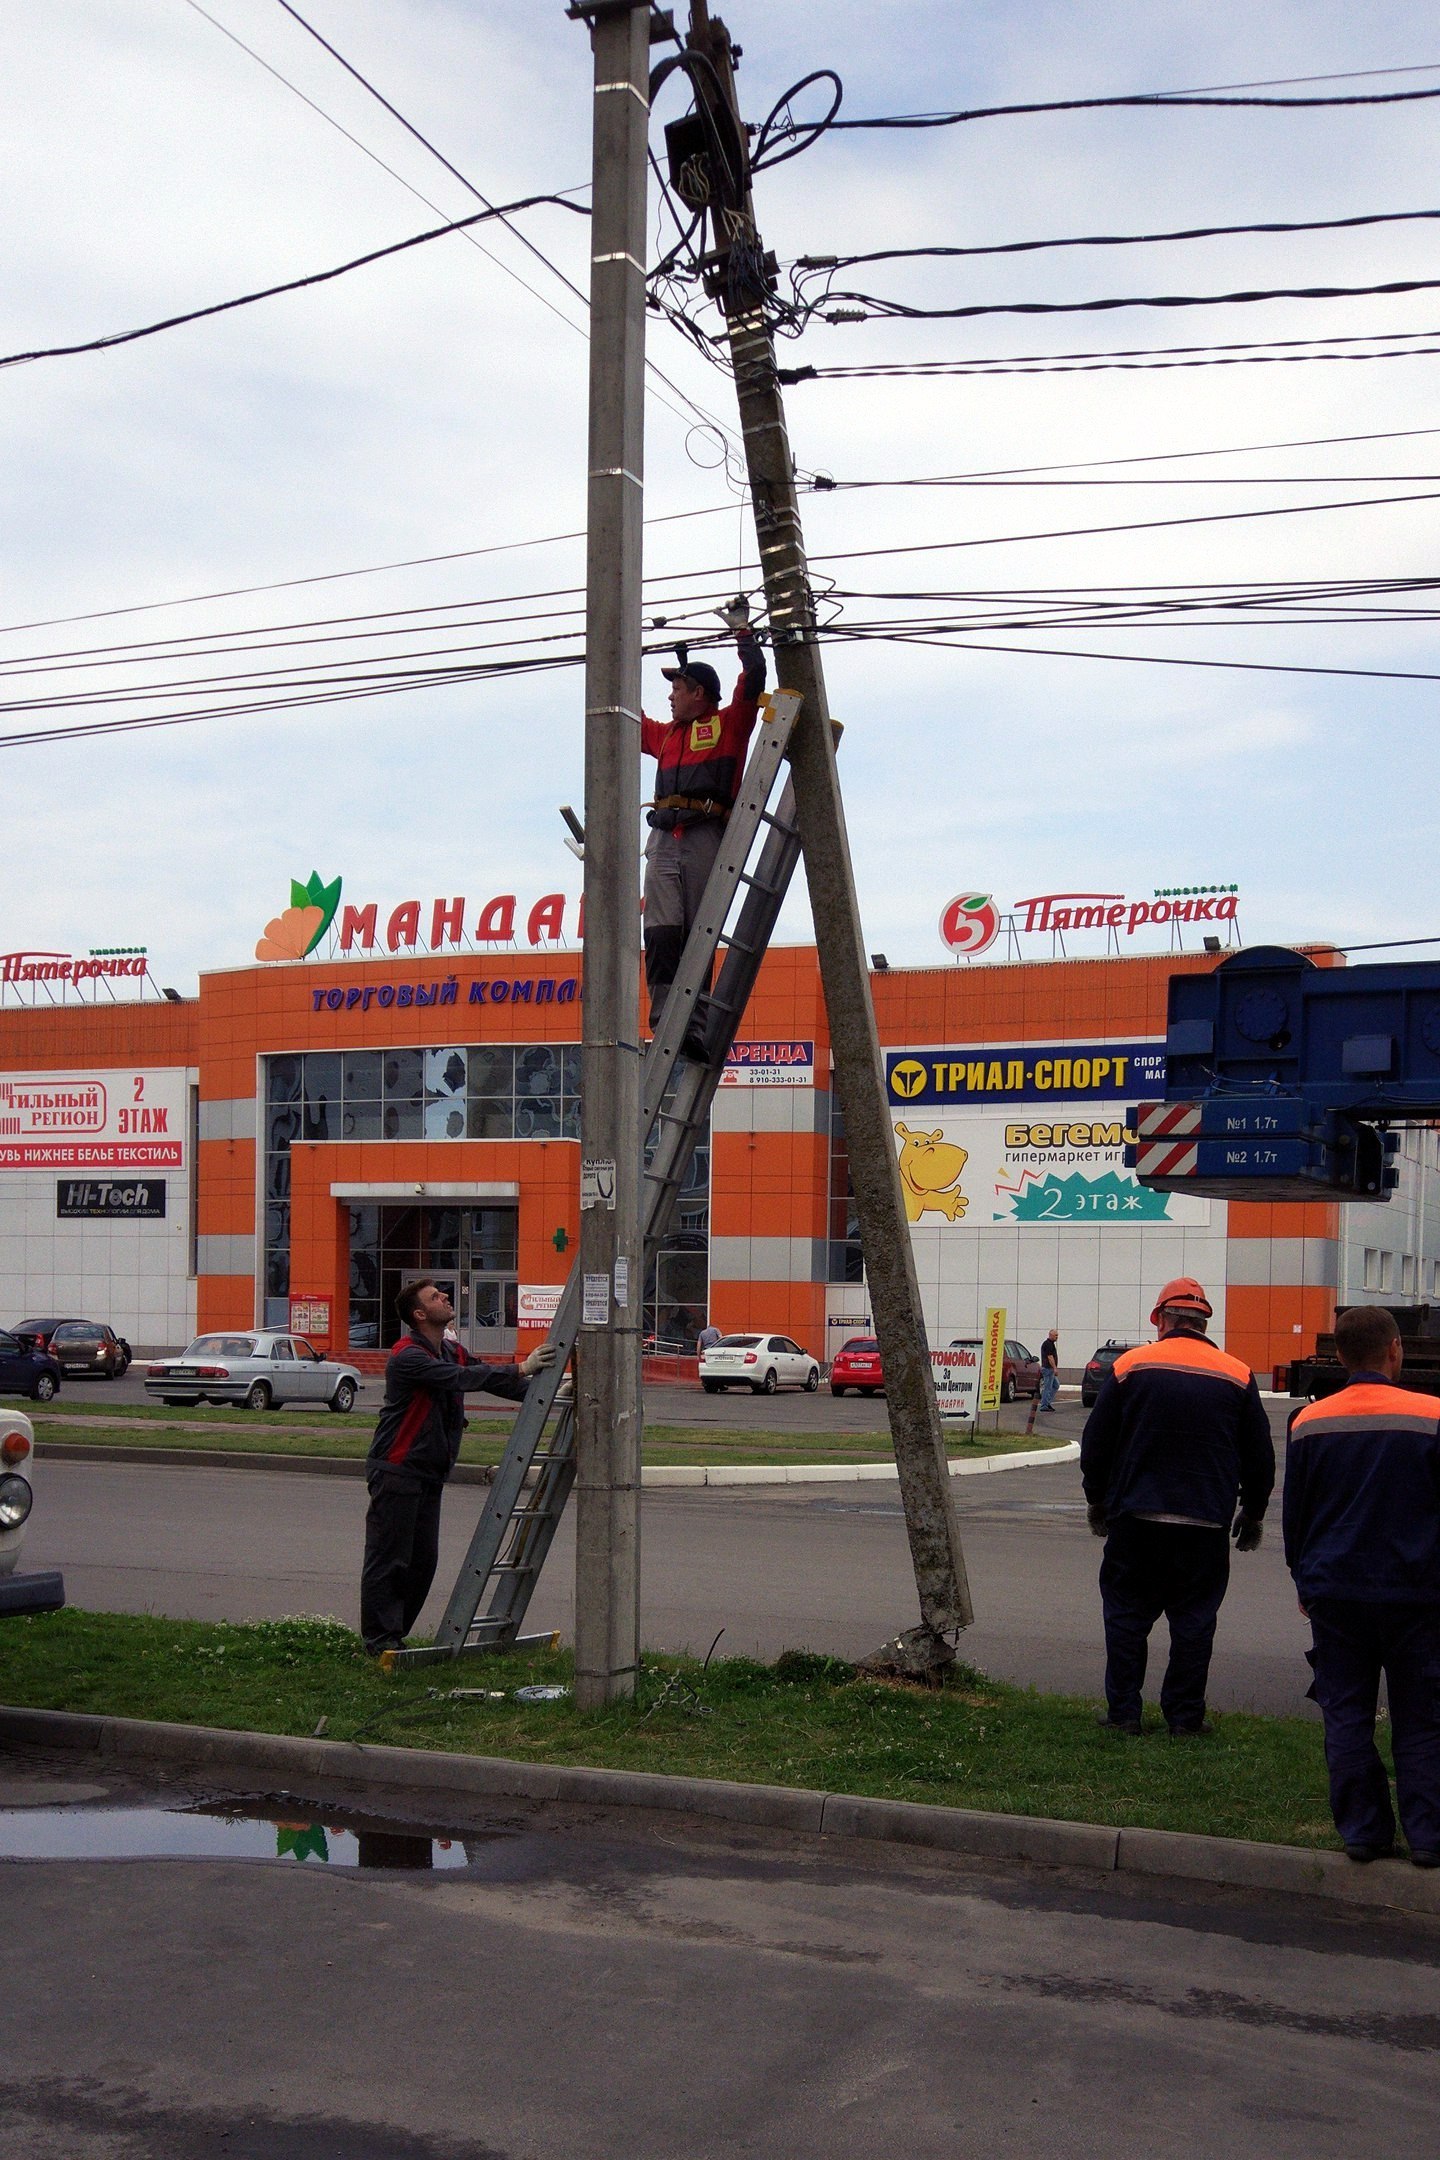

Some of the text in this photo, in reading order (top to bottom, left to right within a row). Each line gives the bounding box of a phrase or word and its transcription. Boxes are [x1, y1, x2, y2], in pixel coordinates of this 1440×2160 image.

[340, 893, 584, 952] МАНДА
[1014, 893, 1241, 935] Пятерочка
[0, 952, 148, 987] Пятерочка
[312, 974, 583, 1011] ТОРГОВЫЙ КОМПЛ
[134, 1076, 144, 1102] 2
[31, 1111, 98, 1126] РЕГИОН
[118, 1108, 168, 1134] ЭТАЖ
[1227, 1117, 1246, 1129] №1
[24, 1148, 75, 1161] НИЖНЕЕ
[77, 1147, 114, 1160] БЕЛЬЕ
[117, 1146, 178, 1160] ТЕКСТИЛЬ
[1005, 1151, 1101, 1165] гипермаркет
[1227, 1151, 1246, 1163] №2
[1037, 1188, 1143, 1219] 2 этаж
[988, 1311, 1001, 1392] АВТОМОЙКА
